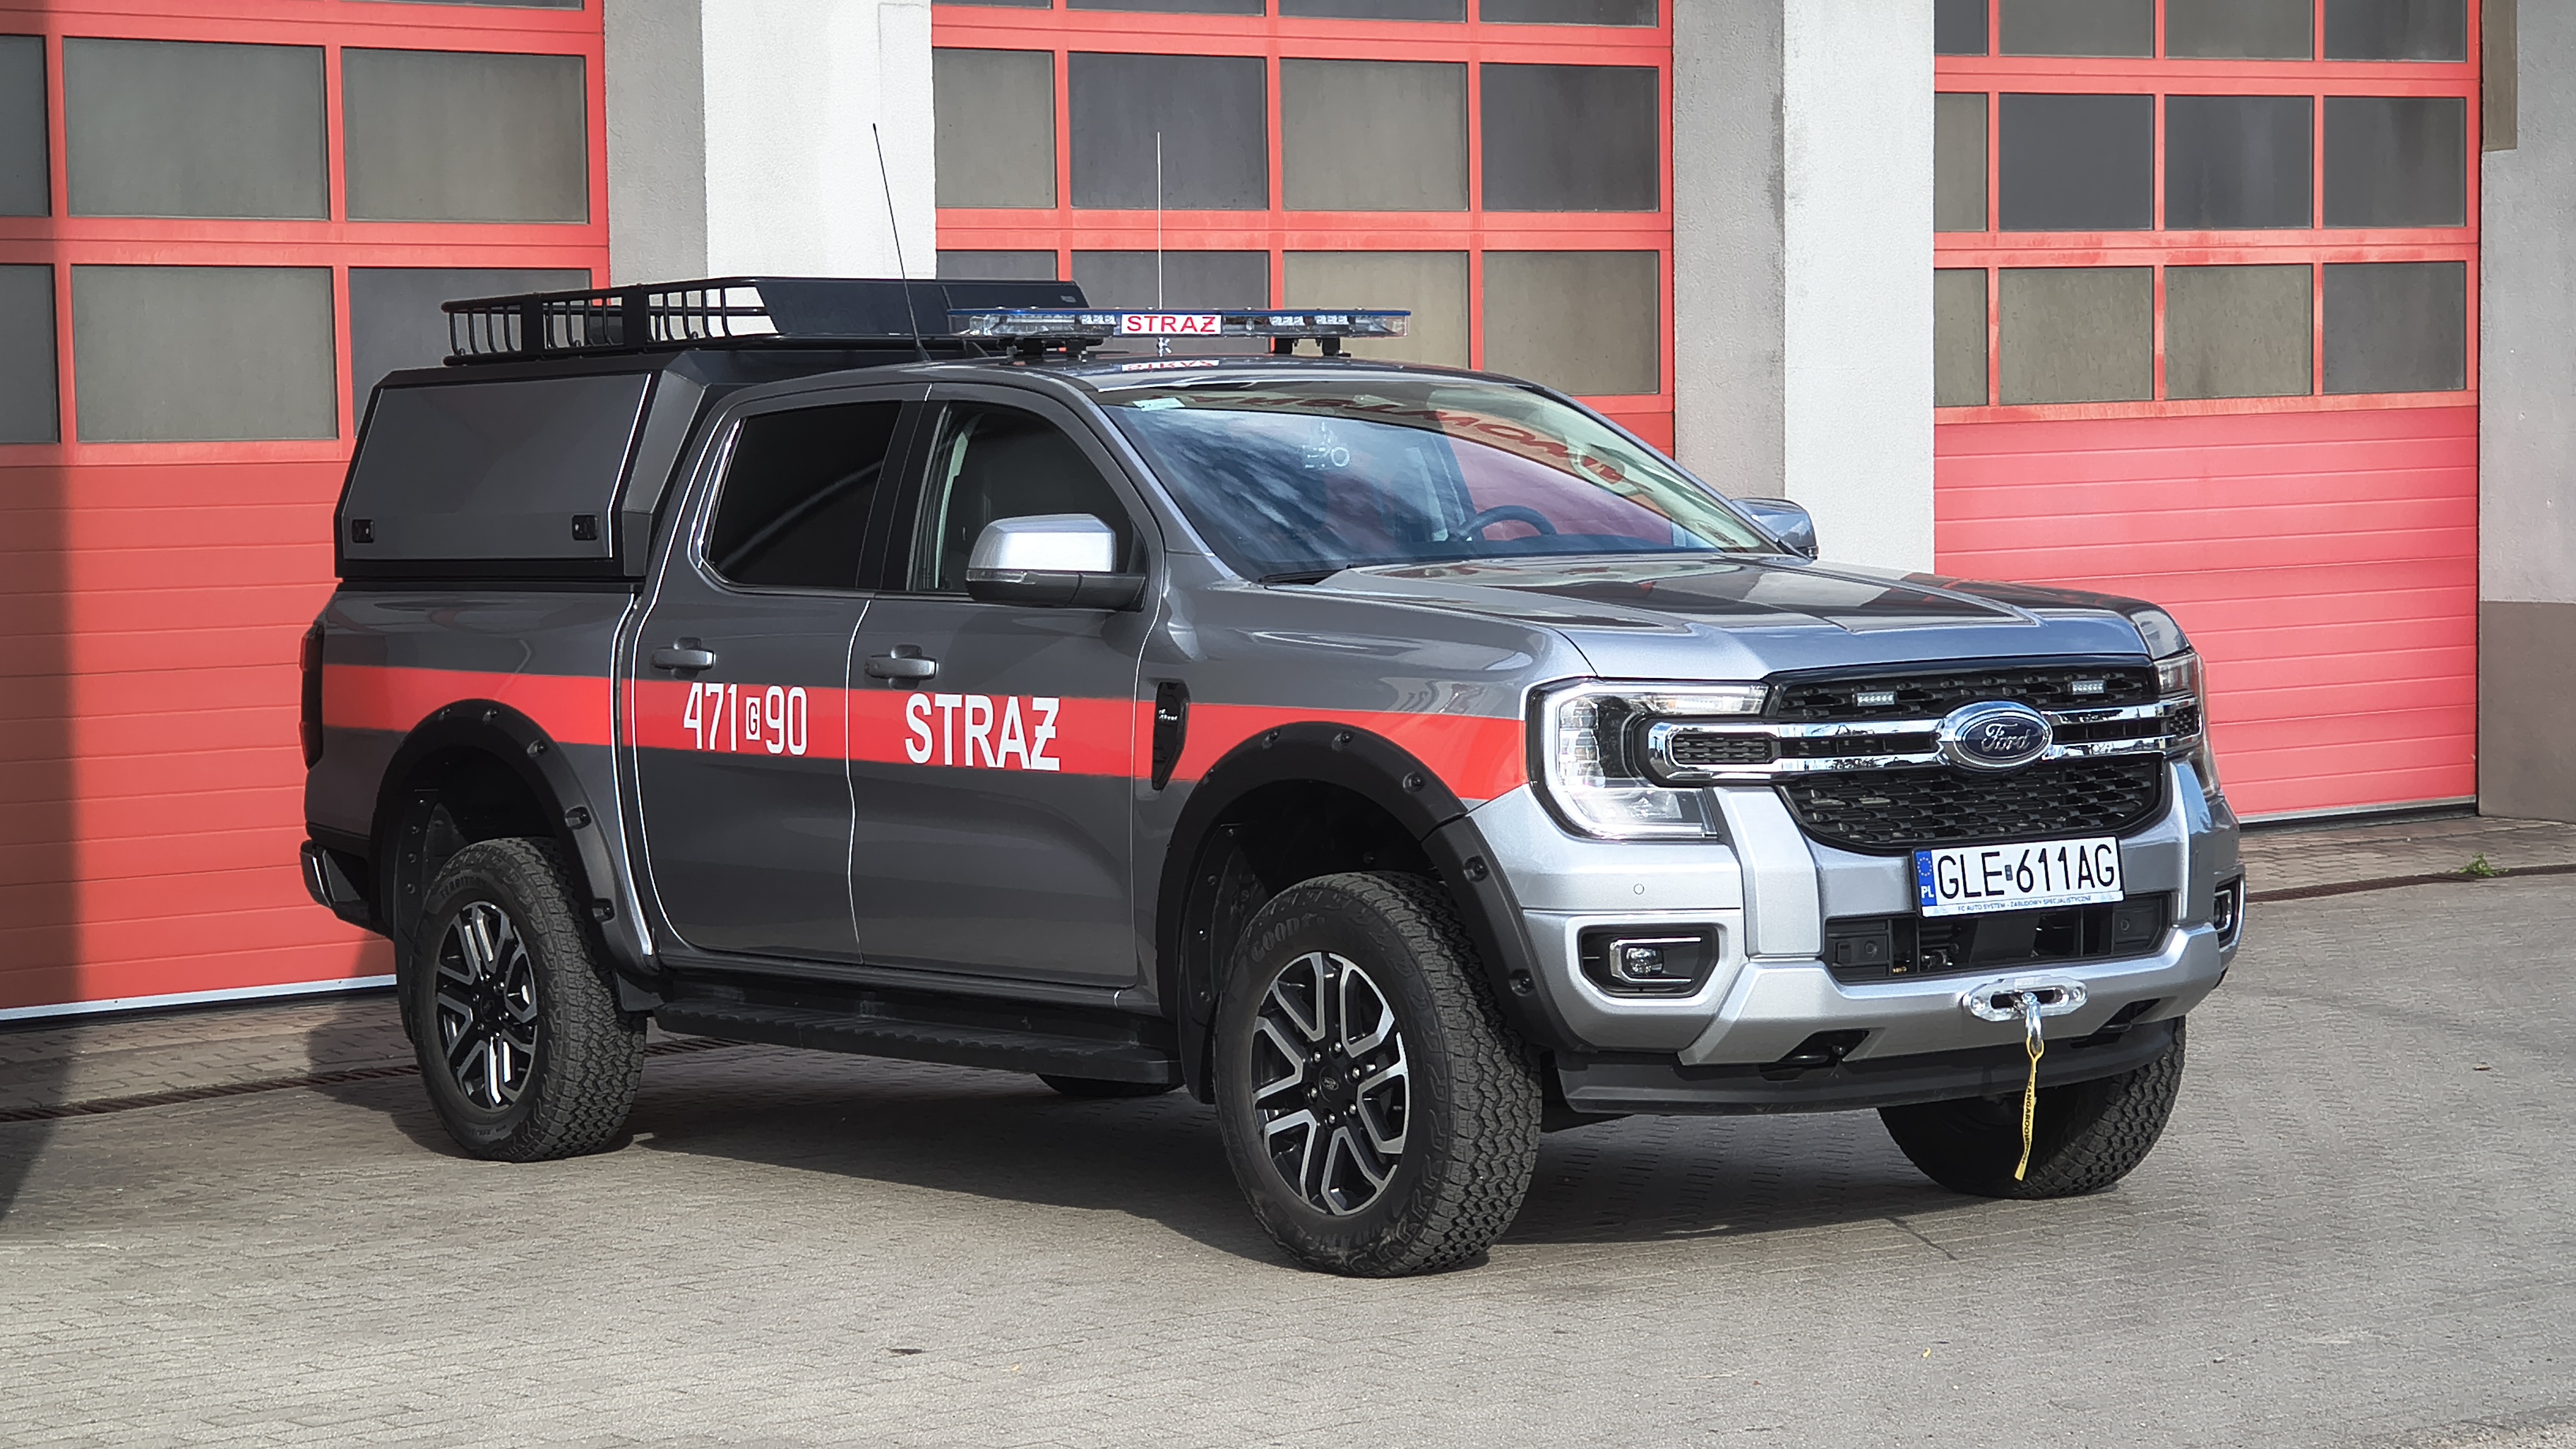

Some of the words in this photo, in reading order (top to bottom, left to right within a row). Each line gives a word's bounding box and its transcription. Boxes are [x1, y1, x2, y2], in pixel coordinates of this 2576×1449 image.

[1127, 316, 1216, 333] STRAŻ
[905, 693, 1060, 771] STRAŻ
[1981, 723, 2031, 752] Ford
[1921, 886, 1935, 899] PL
